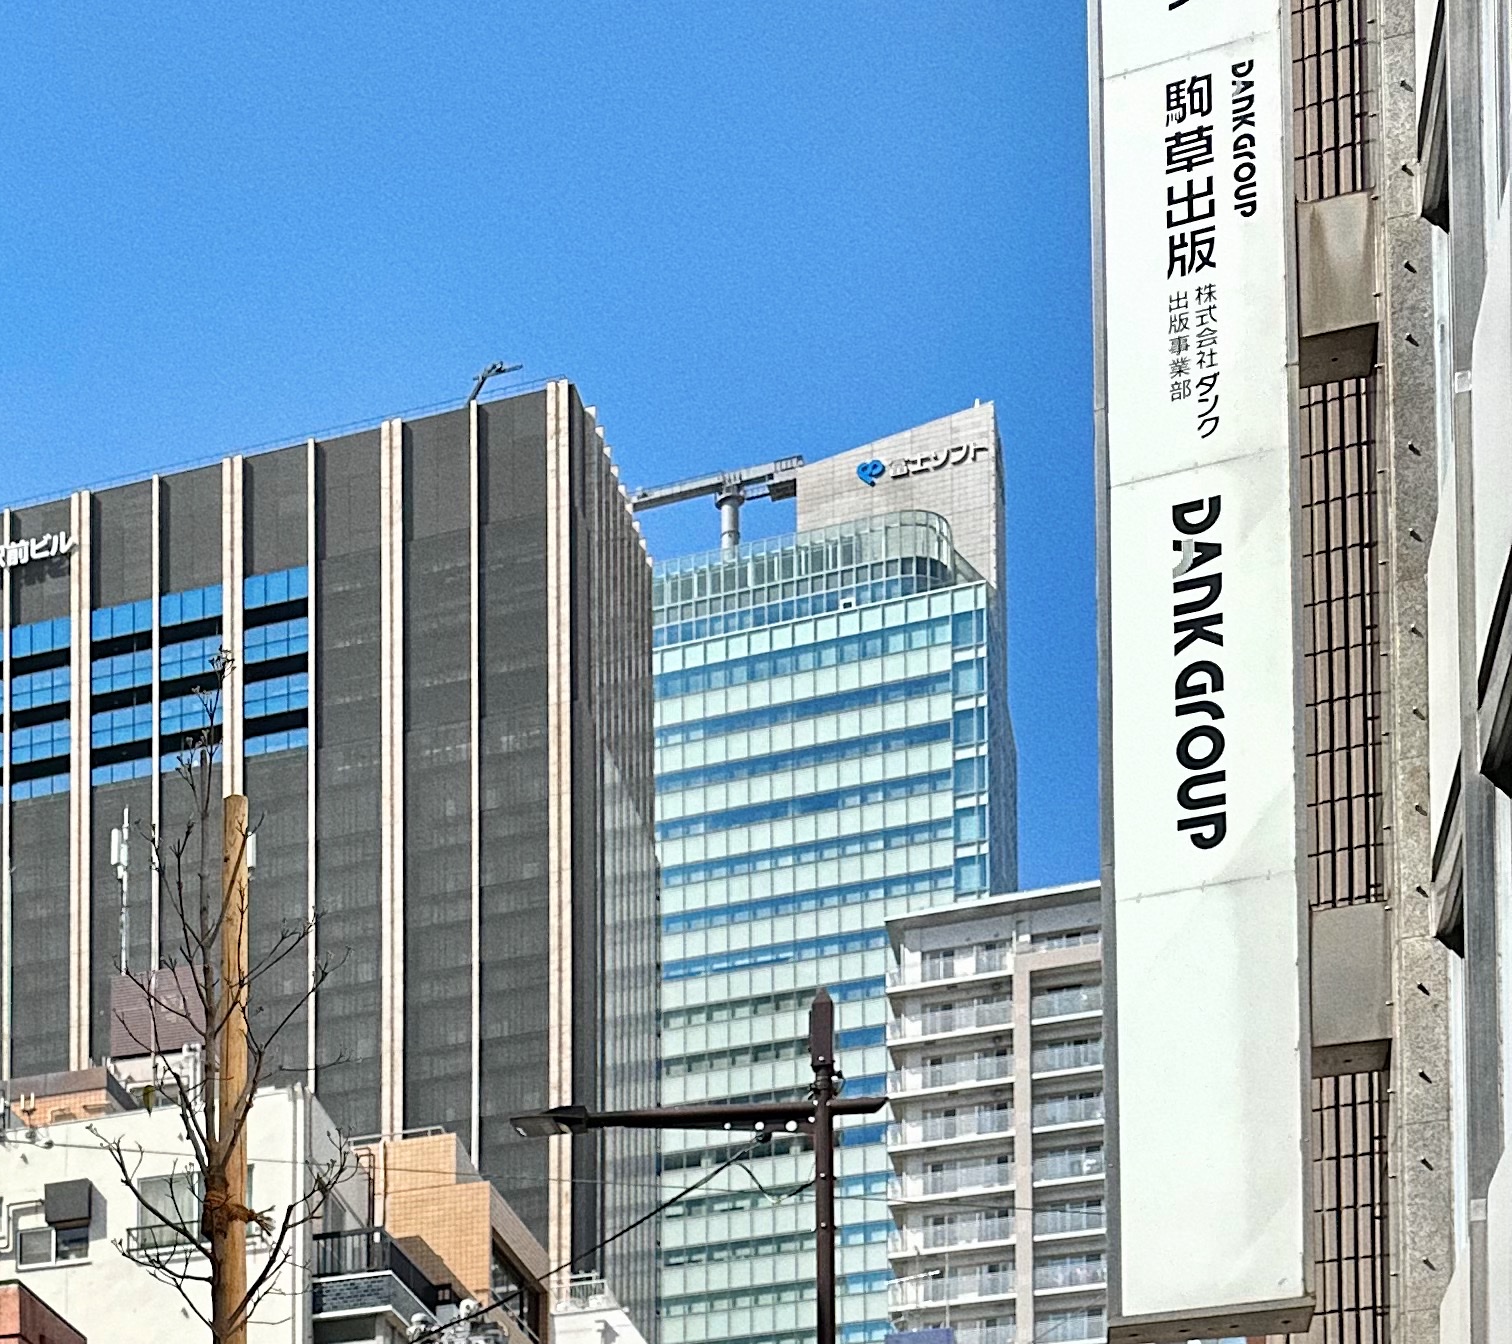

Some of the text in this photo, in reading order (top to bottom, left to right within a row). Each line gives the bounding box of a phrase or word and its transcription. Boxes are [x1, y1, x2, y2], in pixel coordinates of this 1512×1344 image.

[1164, 74, 1217, 281] 駒草出版
[1168, 290, 1191, 402] 出版事業部
